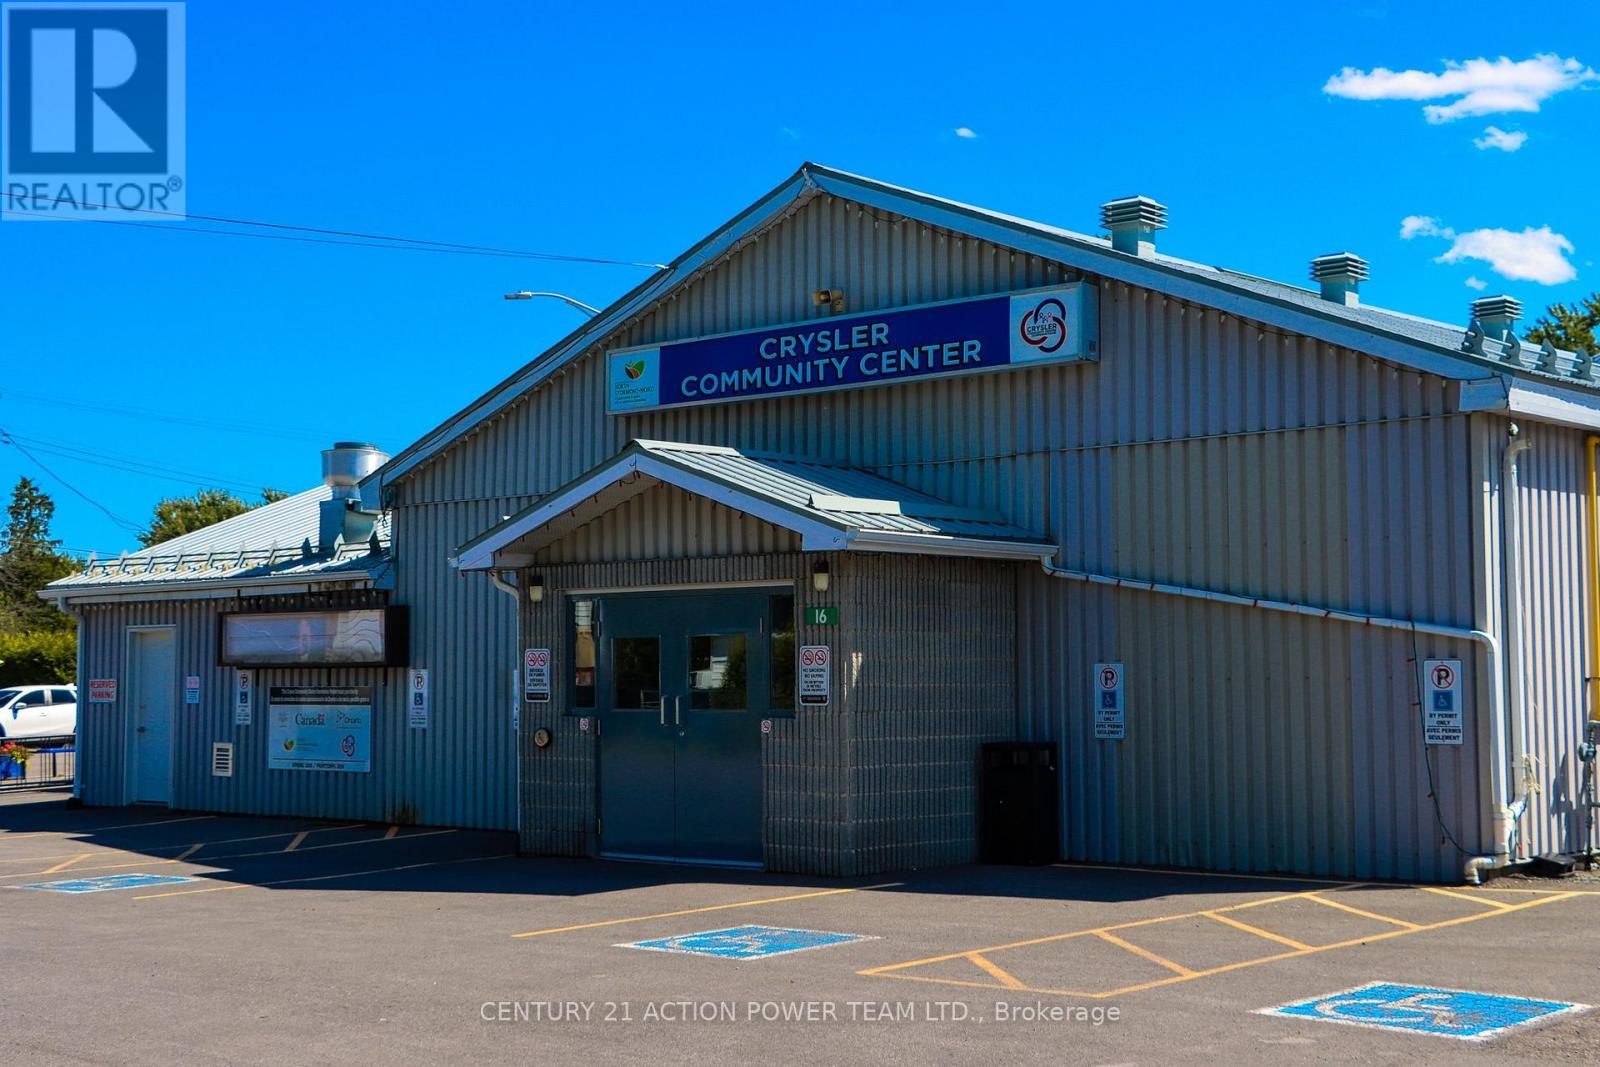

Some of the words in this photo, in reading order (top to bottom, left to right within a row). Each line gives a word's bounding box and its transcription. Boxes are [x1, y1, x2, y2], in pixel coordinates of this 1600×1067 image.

[759, 322, 889, 360] CRYSLER
[1027, 323, 1057, 333] CRYSLER
[680, 355, 849, 397] COMMUNITY
[859, 338, 982, 375] CENTER
[815, 608, 827, 624] 16
